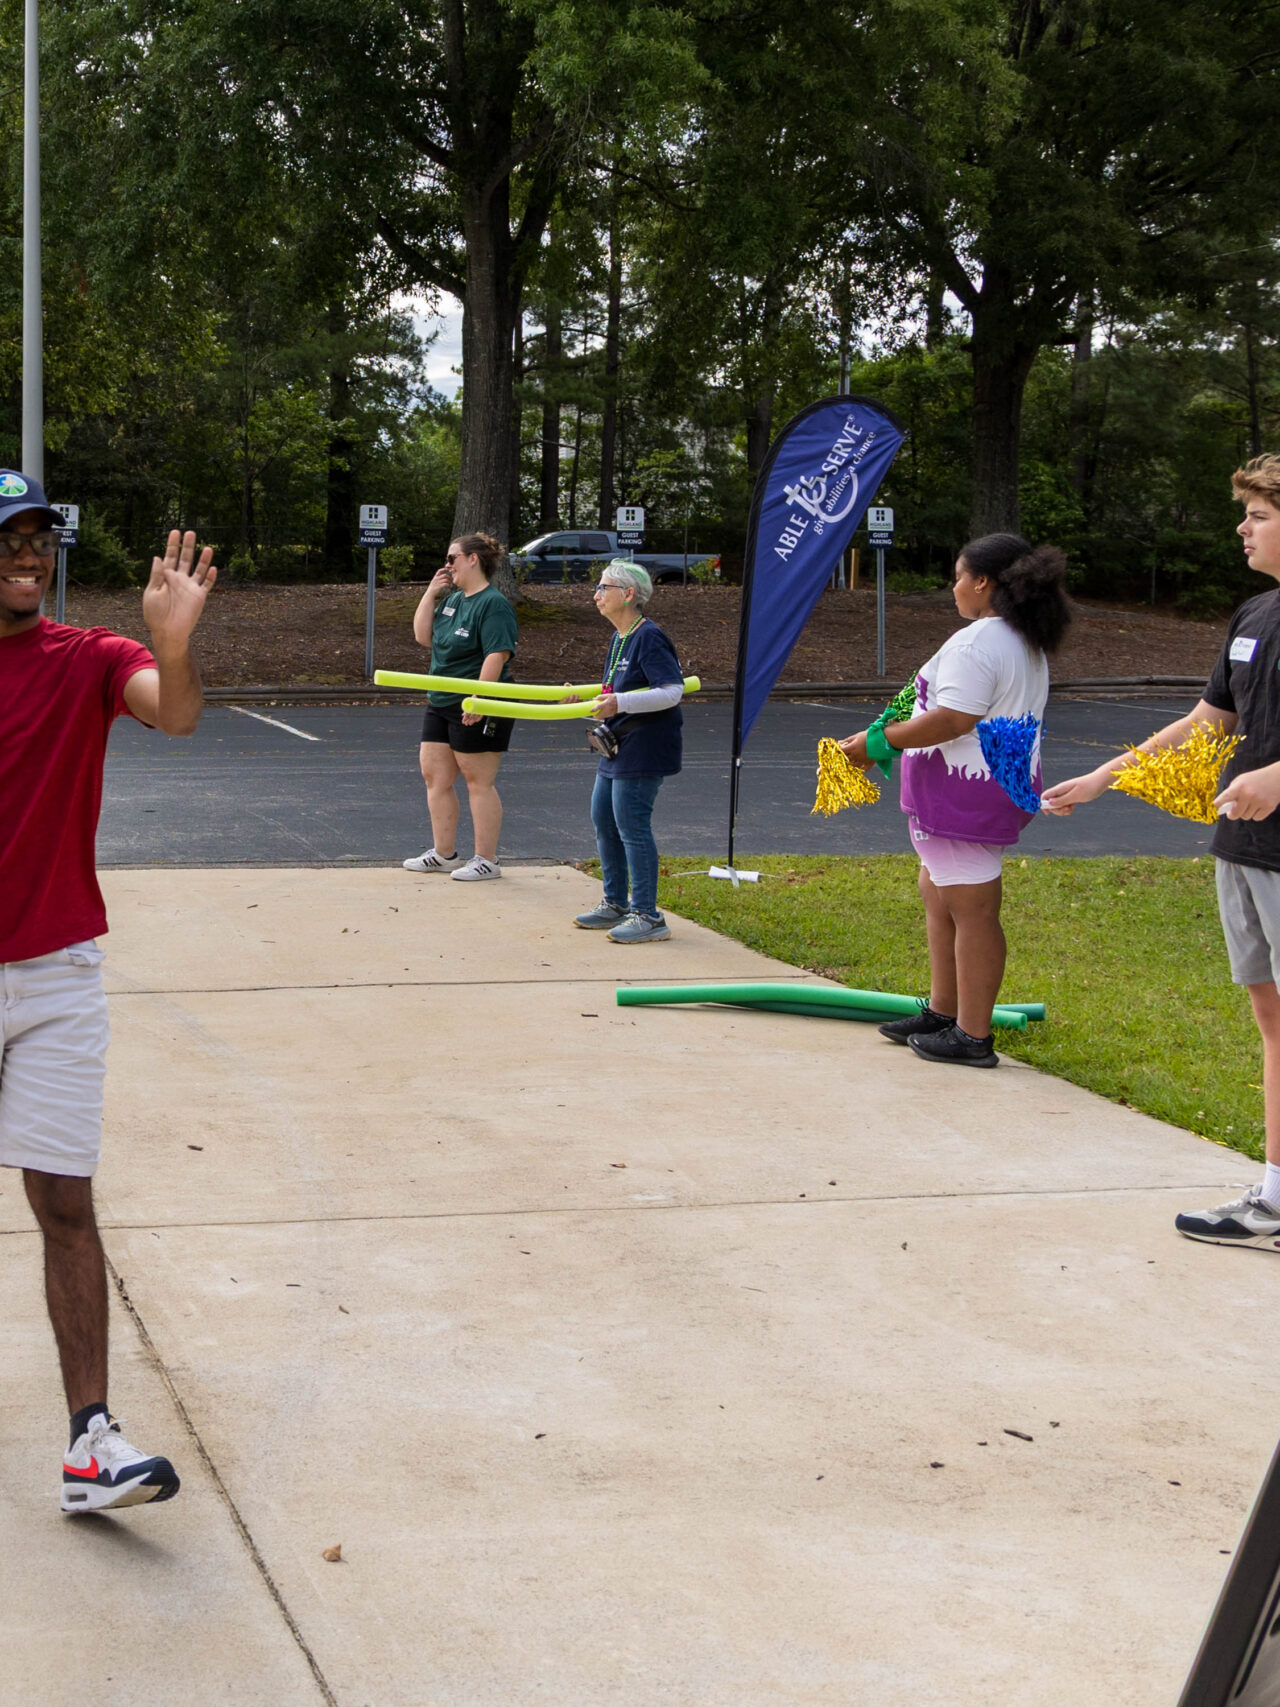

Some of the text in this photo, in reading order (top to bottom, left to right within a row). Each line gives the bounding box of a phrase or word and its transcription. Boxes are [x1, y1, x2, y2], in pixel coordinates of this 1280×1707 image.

[825, 473, 851, 512] abilities
[848, 465, 856, 474] a
[852, 431, 877, 465] chance
[774, 513, 809, 562] ABLE
